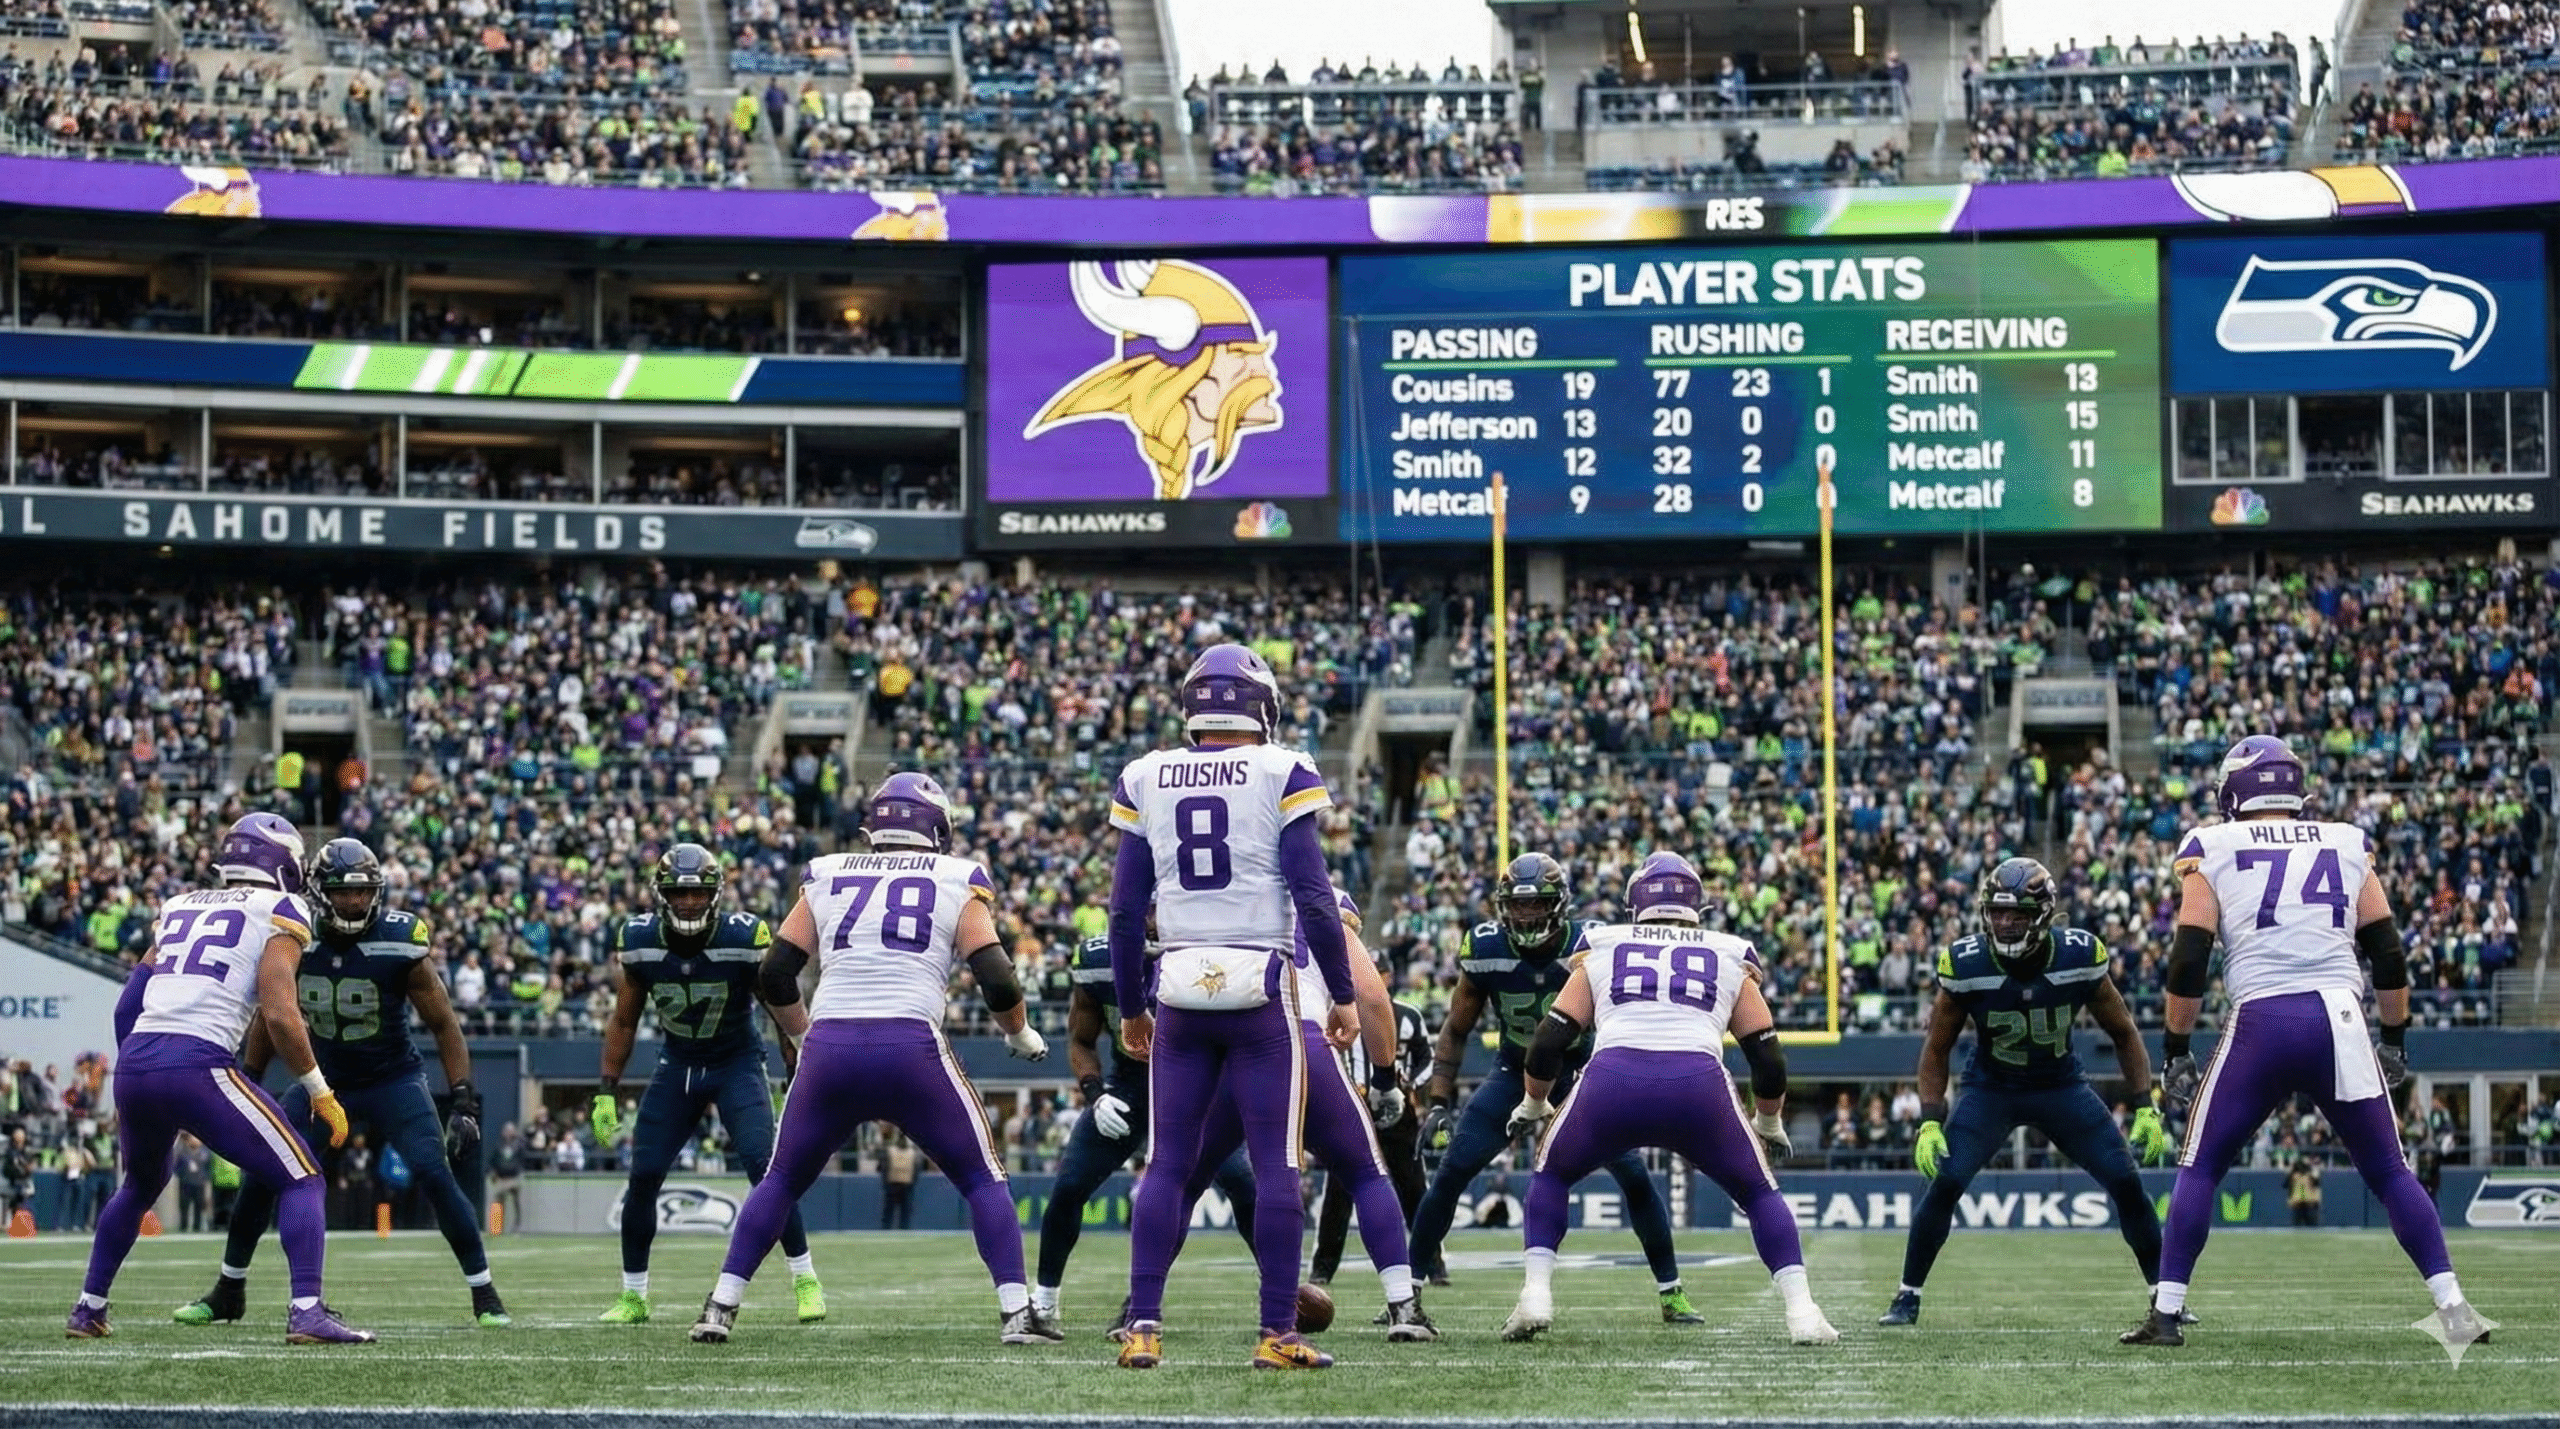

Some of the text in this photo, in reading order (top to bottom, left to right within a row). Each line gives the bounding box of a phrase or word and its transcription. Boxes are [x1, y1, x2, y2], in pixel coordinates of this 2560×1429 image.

[1705, 196, 1765, 231] RES
[1569, 256, 1926, 307] PLAYER STATS
[1391, 326, 1538, 360] PASSING
[1651, 322, 1805, 355] RUSHING
[1886, 317, 2068, 350] RECEIVING
[1391, 371, 1596, 403] Cousins 19
[1653, 367, 1831, 398] 77 23 1
[1887, 363, 2098, 395] Smith 13
[1391, 408, 1597, 441] Jefferson 13
[1653, 405, 1836, 436] 20 0 0
[1887, 401, 2099, 433] Smith 15
[1392, 447, 1597, 479] Smith 12
[1653, 443, 1837, 475] 32 2 0
[1888, 439, 2095, 471] Metcalf 11
[1569, 485, 1591, 515] 9
[1653, 484, 1693, 513] 28
[1742, 483, 1764, 512] 0
[1889, 478, 2094, 510] Metcalf 8
[2361, 492, 2535, 515] SEAHAWKS
[0, 497, 666, 550] L SAHOME FIELDS
[999, 511, 1167, 534] SEAHAWKS
[1158, 760, 1249, 789] COUSINS
[1175, 795, 1232, 892] 8
[2235, 849, 2349, 931] 74
[830, 875, 937, 954] 78
[152, 909, 246, 983] 22
[1609, 942, 1719, 1013] 68
[298, 974, 381, 1041] 99
[653, 981, 729, 1039] 27
[1987, 1004, 2071, 1066] 24
[1732, 1193, 2111, 1228] EAHWKS
